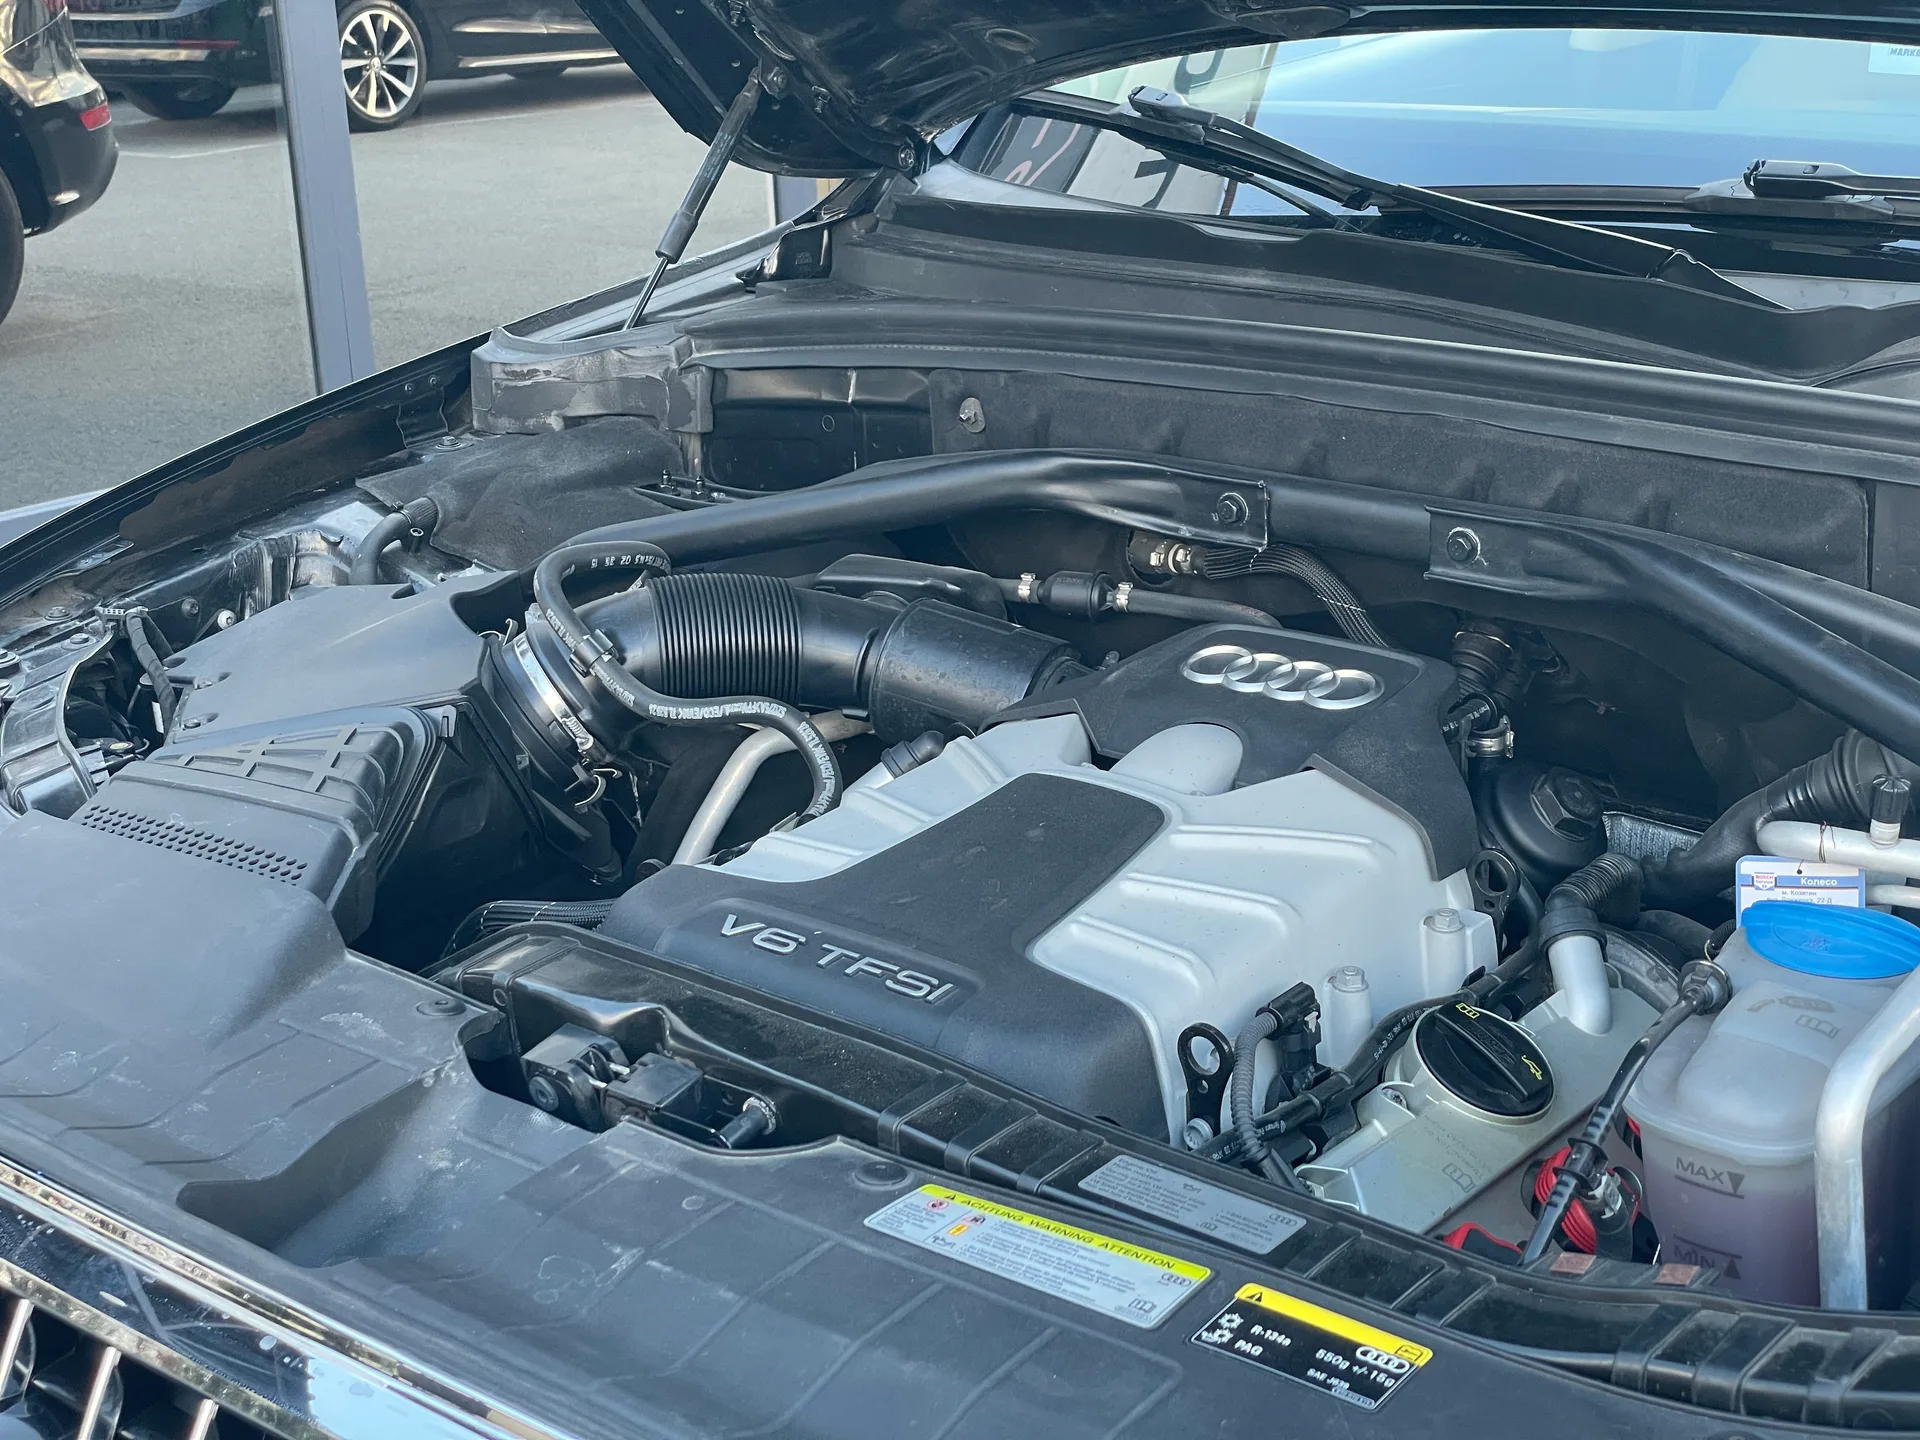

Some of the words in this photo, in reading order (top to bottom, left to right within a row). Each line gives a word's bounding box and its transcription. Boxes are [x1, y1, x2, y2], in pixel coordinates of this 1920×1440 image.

[1800, 877, 1838, 886] Колесо
[720, 914, 807, 956] V6
[816, 943, 955, 1005] TFSI
[1676, 1157, 1725, 1185] MAX
[961, 1199, 1024, 1222] ACHTUNG
[1029, 1219, 1094, 1244] WARNING
[1097, 1241, 1176, 1270] ATTENTION
[1673, 1243, 1716, 1268] MIN
[1234, 1339, 1264, 1357] PAG
[1250, 1324, 1292, 1347] R-134a
